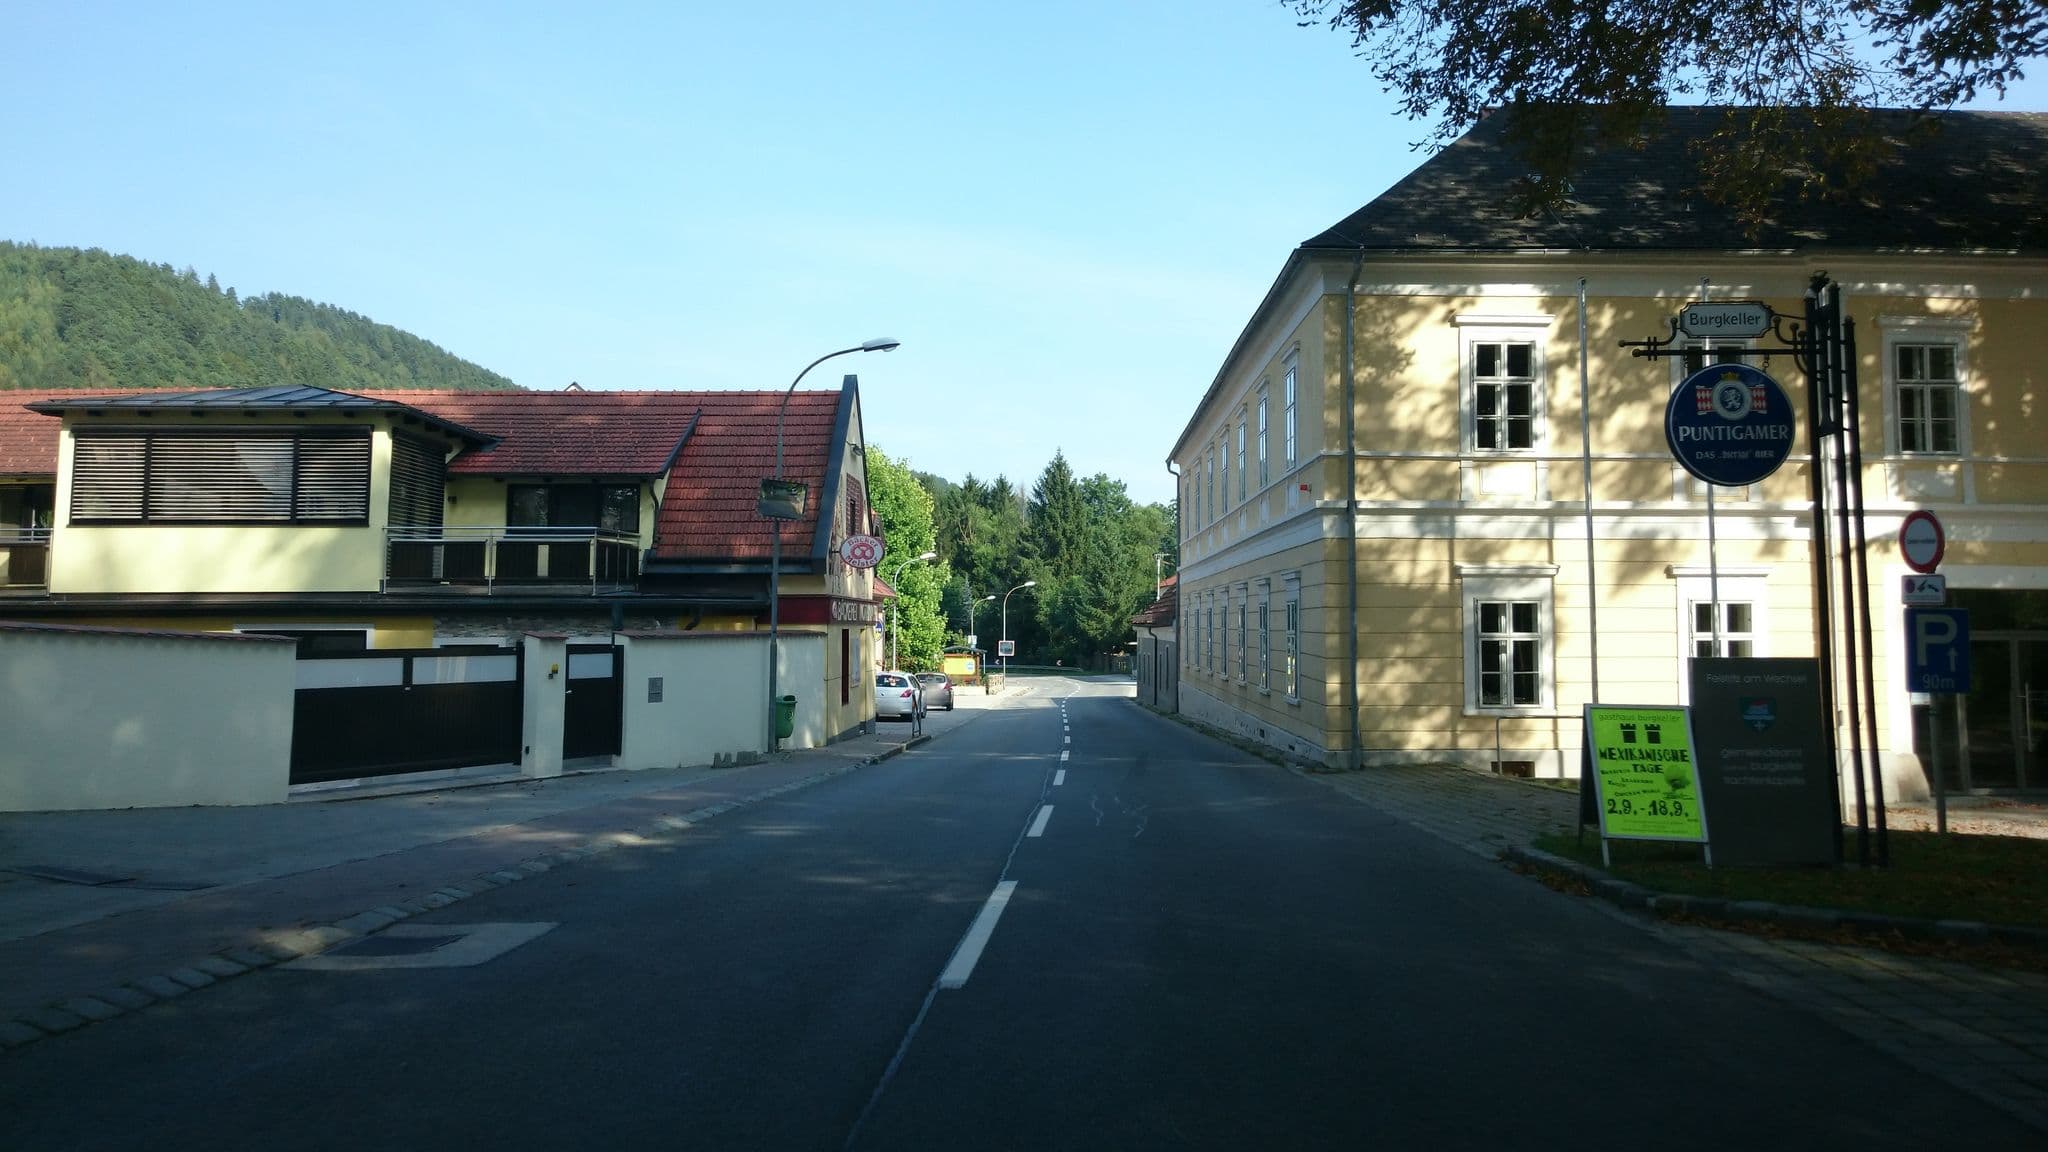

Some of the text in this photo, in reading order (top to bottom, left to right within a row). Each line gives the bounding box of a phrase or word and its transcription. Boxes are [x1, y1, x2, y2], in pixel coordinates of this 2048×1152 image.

[1689, 313, 1761, 328] Burgkeller
[1678, 424, 1790, 442] PUNTIGAMER
[1696, 451, 1716, 460] DAS
[1916, 614, 1957, 666] P
[1599, 747, 1690, 763] MEXIKANISCHE
[1632, 763, 1664, 774] TAGE
